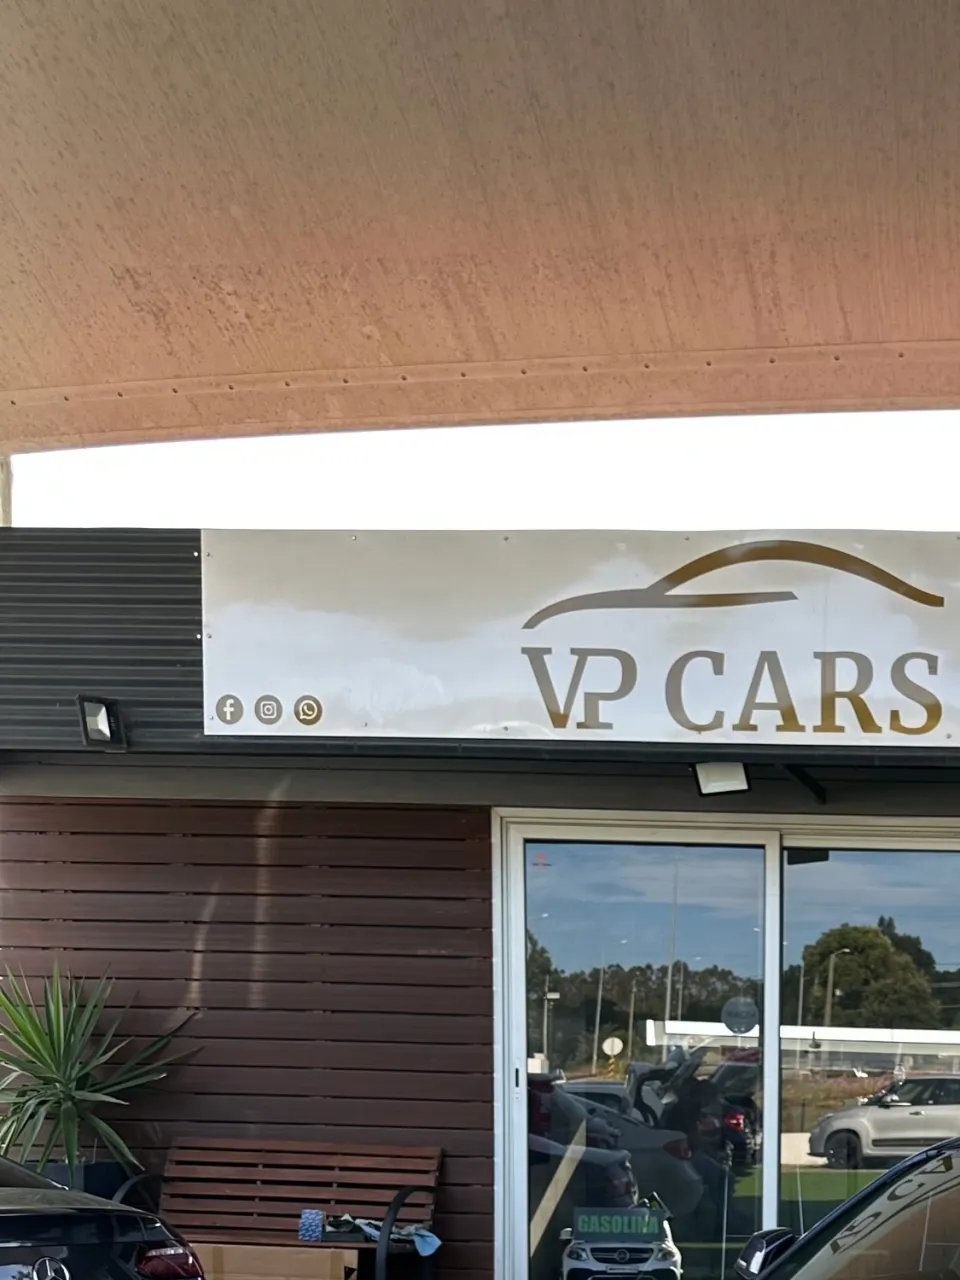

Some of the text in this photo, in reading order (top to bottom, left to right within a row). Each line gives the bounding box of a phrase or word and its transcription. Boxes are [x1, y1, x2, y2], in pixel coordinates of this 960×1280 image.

[521, 647, 943, 736] VP CARS
[577, 1214, 659, 1235] GASOLINA
